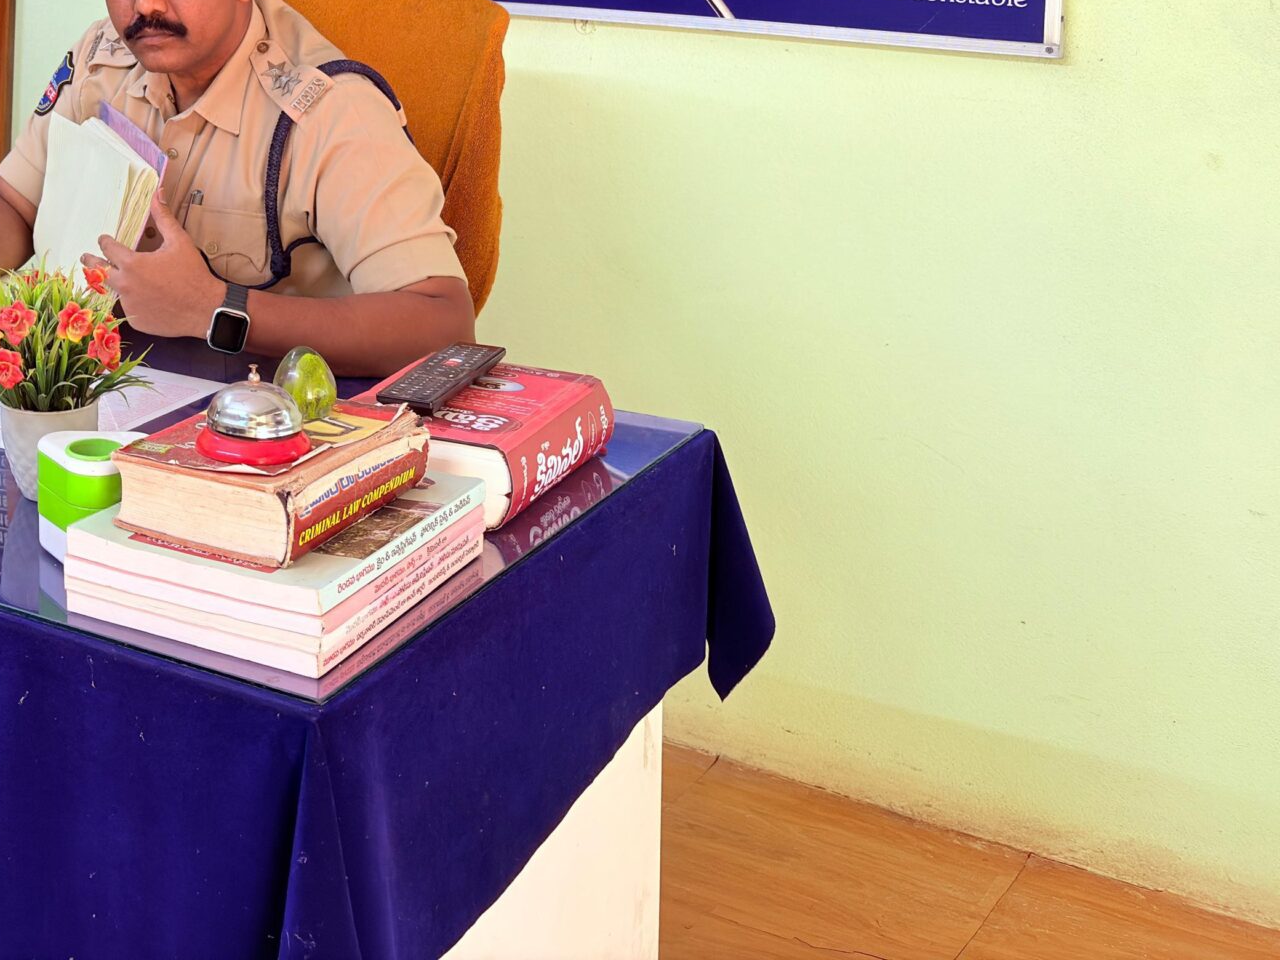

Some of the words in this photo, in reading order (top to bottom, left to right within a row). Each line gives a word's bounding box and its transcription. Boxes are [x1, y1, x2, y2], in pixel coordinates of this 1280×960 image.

[299, 510, 341, 546] CRIMINAL
[343, 498, 361, 520] LAW
[362, 466, 416, 509] COMPENDIUM
